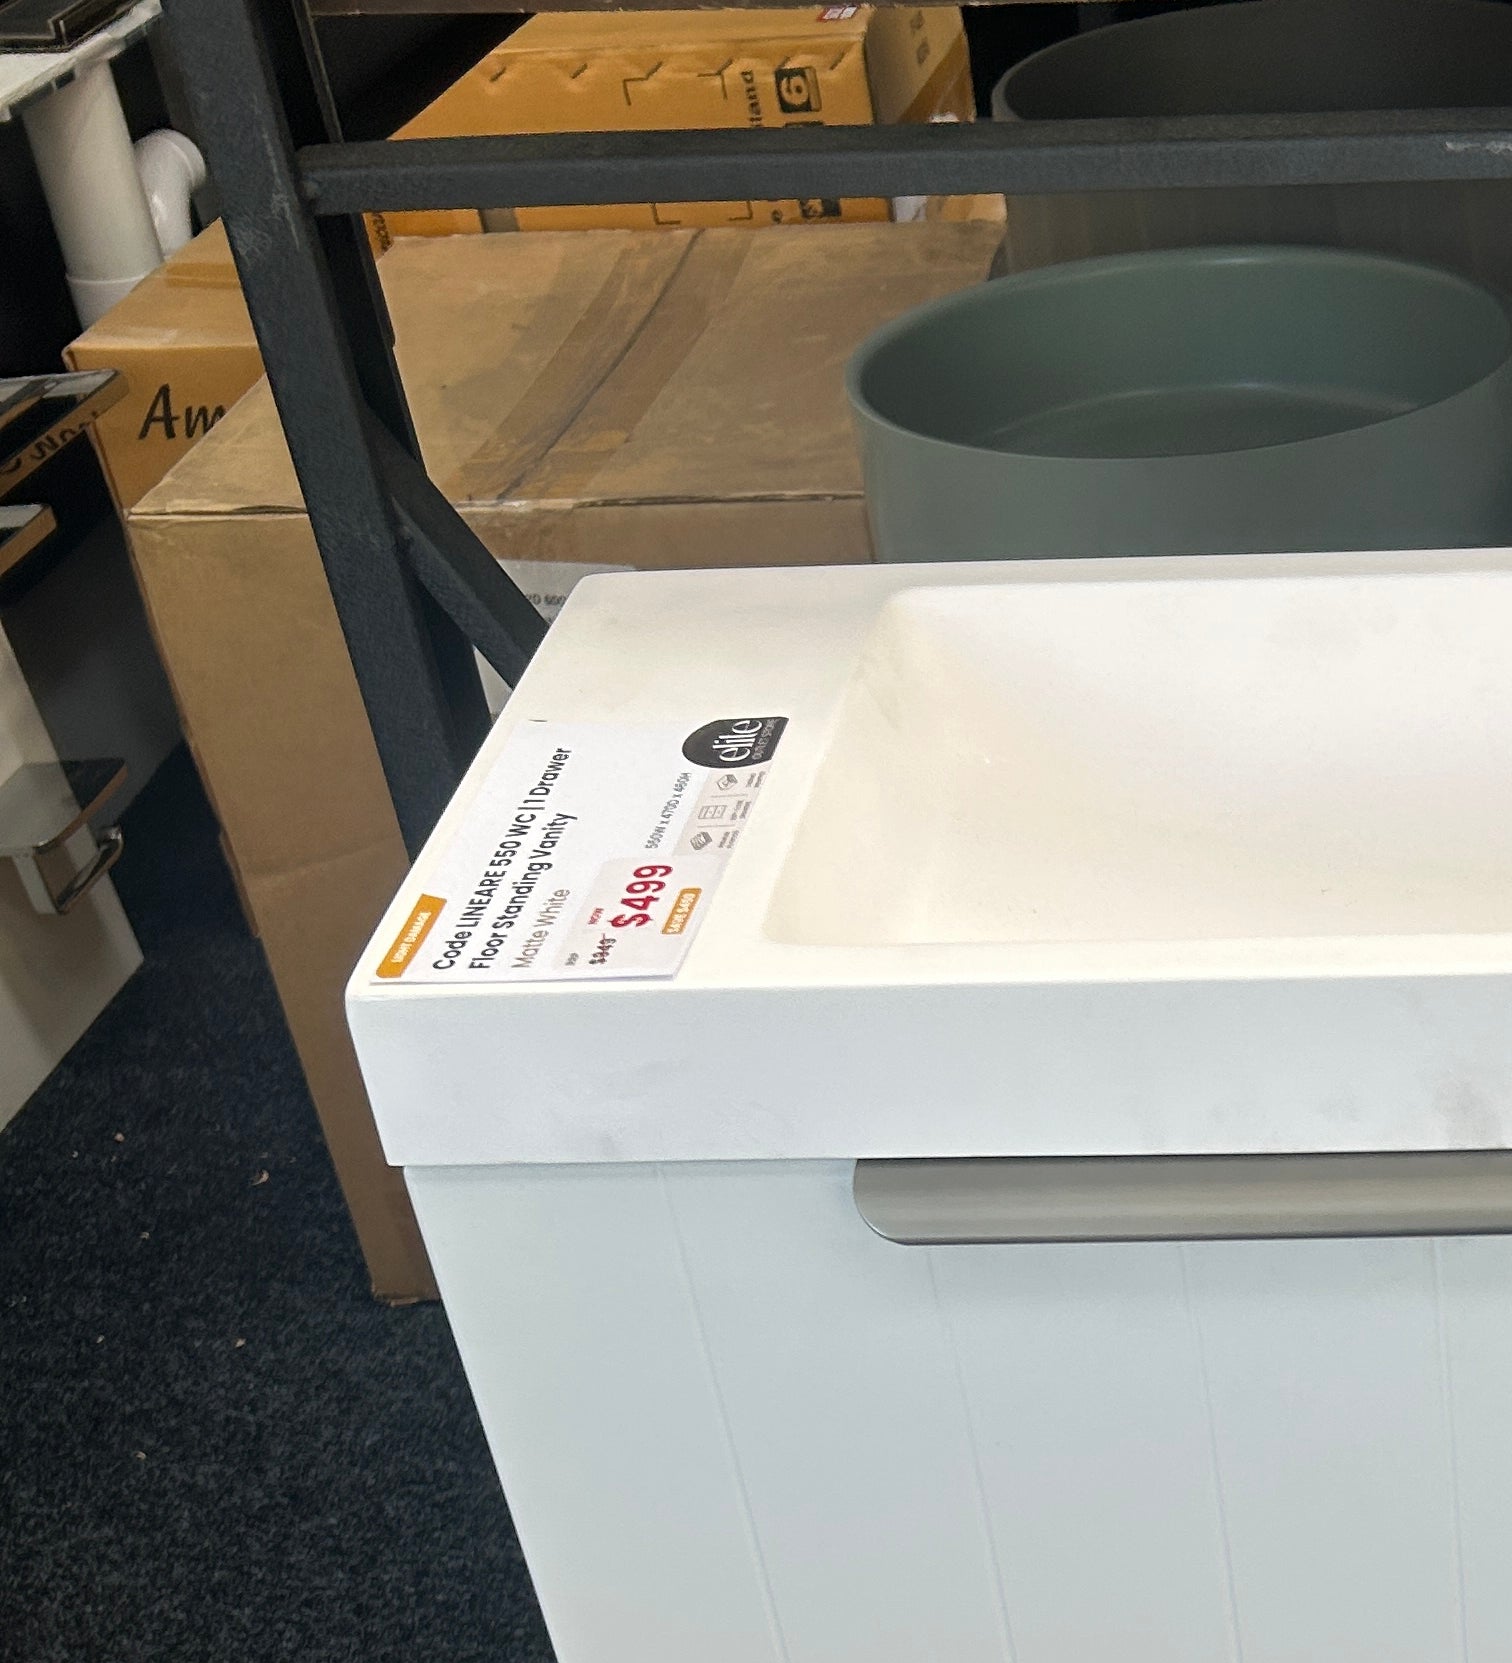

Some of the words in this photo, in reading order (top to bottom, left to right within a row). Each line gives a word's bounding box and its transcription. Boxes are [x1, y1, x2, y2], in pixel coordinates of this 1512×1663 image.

[712, 720, 762, 761] elite
[432, 931, 472, 970] Code
[455, 870, 507, 927] LINEARE
[489, 840, 521, 866] 550
[505, 813, 537, 837] WC
[528, 747, 572, 795] Drawer
[468, 932, 508, 969] Floor
[491, 862, 553, 929] Standing
[528, 812, 578, 859] Vanity
[607, 864, 674, 928] $499
[511, 930, 549, 968] Matte
[533, 889, 570, 928] White
